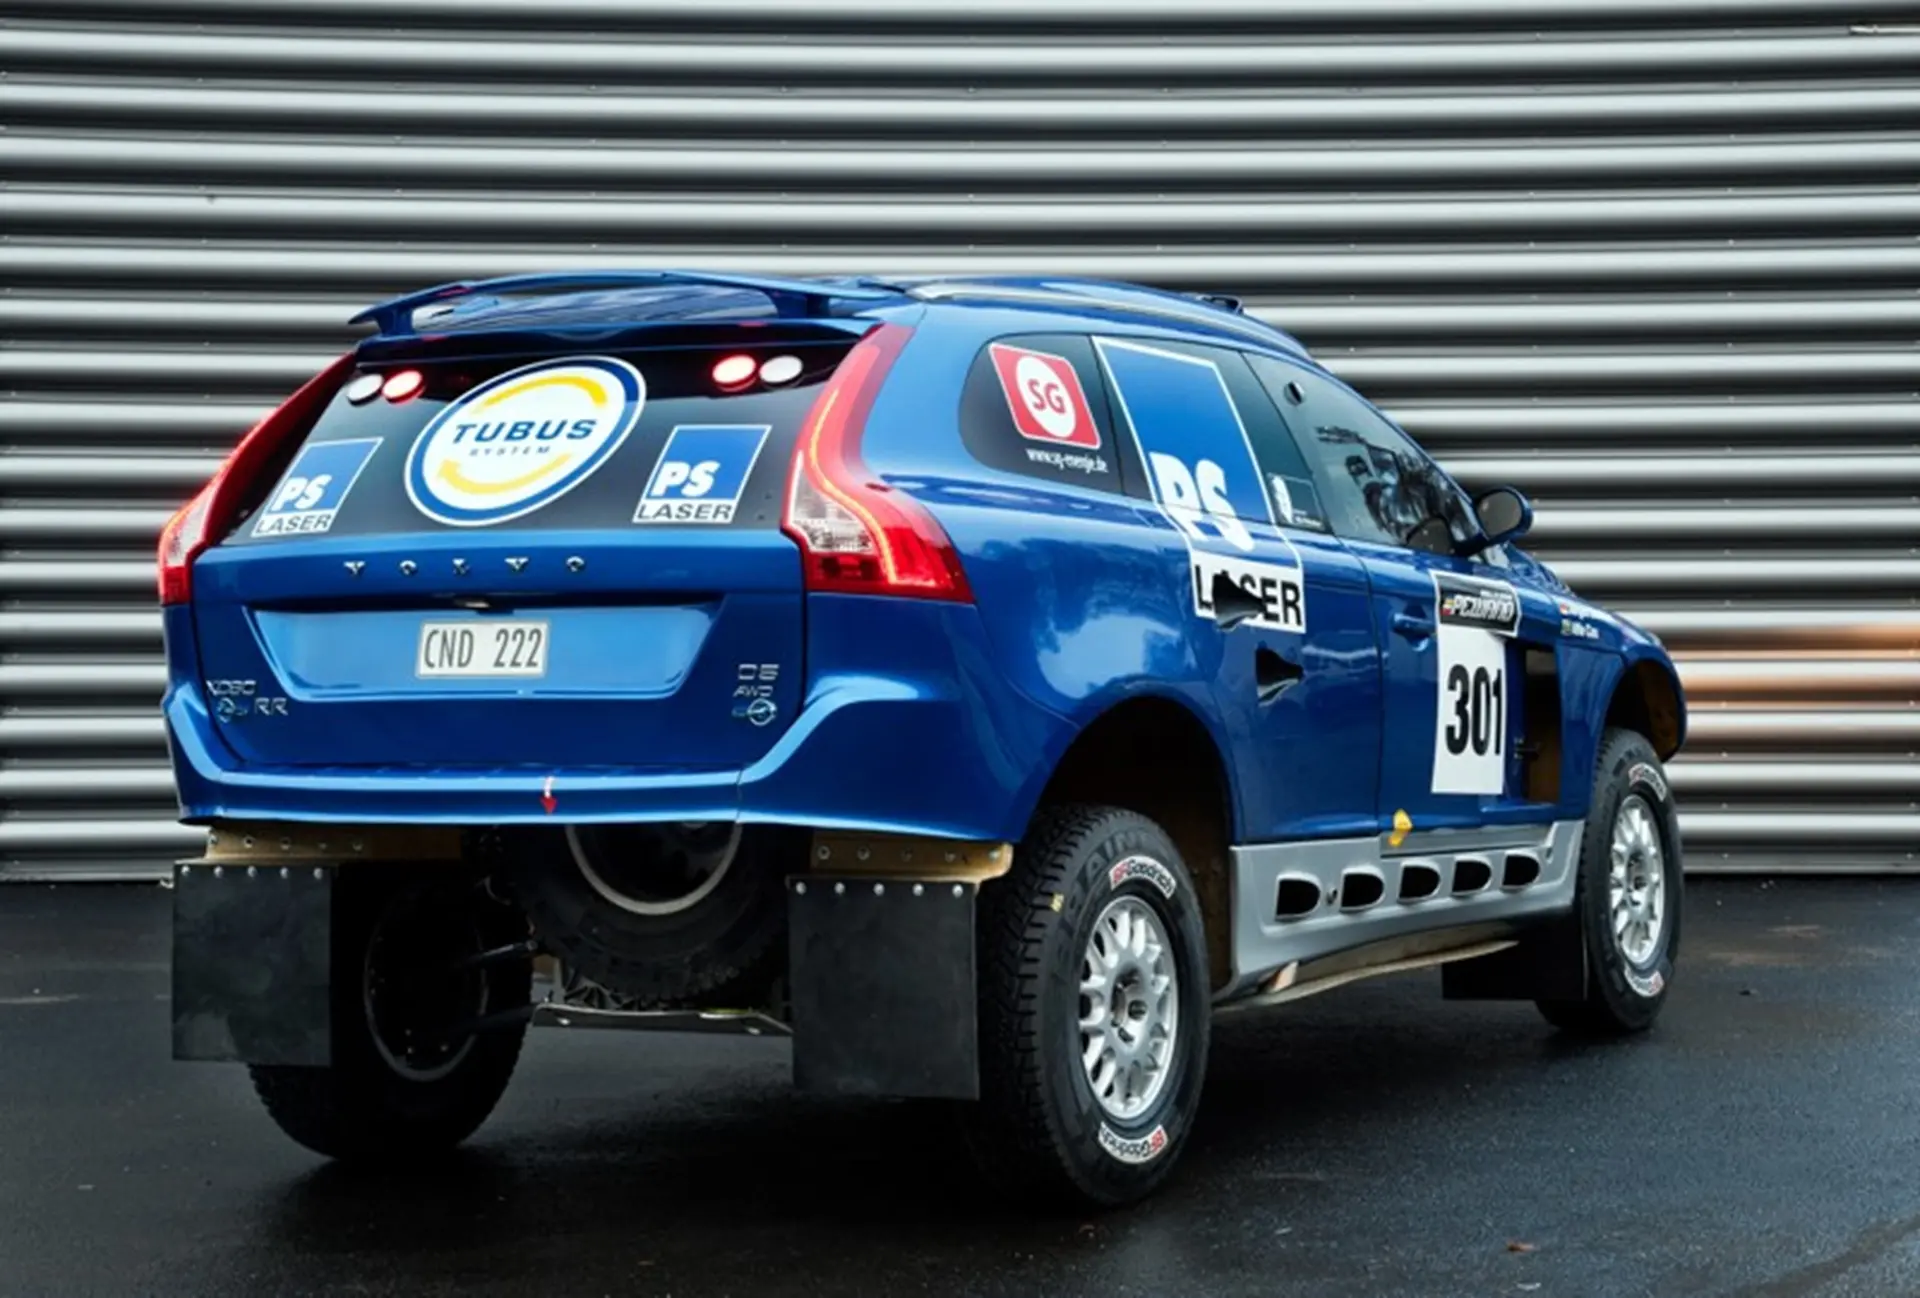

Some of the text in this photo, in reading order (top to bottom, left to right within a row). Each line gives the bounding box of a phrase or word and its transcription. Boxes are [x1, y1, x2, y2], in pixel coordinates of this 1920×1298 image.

[1027, 379, 1066, 414] SG
[453, 419, 597, 445] TUBUS
[469, 446, 552, 457] SYSTEM
[650, 460, 721, 497] PS
[270, 474, 332, 511] PS
[1148, 451, 1255, 552] PS
[256, 514, 332, 534] LASER
[637, 503, 733, 520] LASER
[343, 555, 585, 576] VOLVO
[424, 628, 543, 669] CND 222
[732, 684, 774, 697] AWD
[254, 697, 288, 716] RR
[1445, 664, 1502, 756] 301
